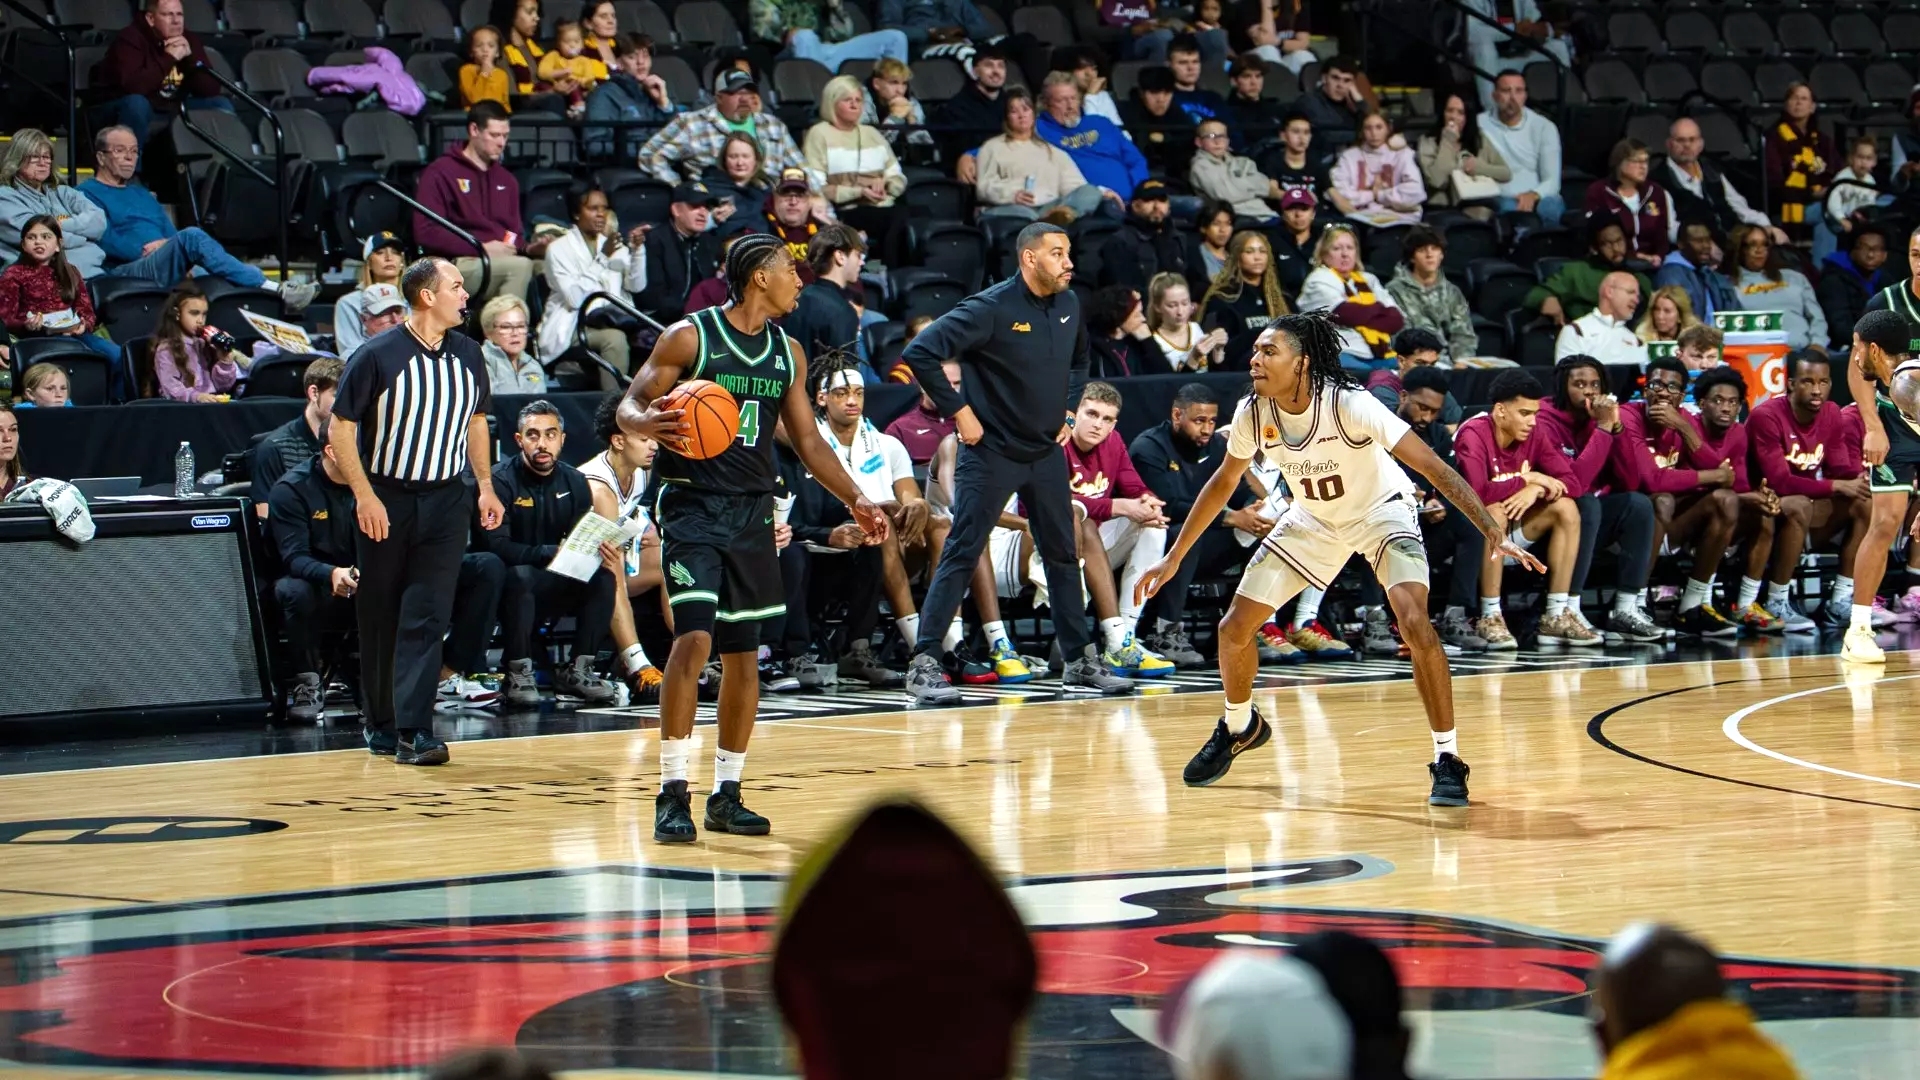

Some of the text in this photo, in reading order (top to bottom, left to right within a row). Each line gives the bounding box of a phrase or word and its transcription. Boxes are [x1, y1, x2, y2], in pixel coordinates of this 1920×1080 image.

[715, 373, 783, 398] NORTH TEXAS
[1761, 357, 1785, 394] G
[736, 400, 760, 447] 4
[1299, 474, 1345, 502] 10
[193, 516, 228, 526] Van Wagner
[415, 806, 516, 818] AT
